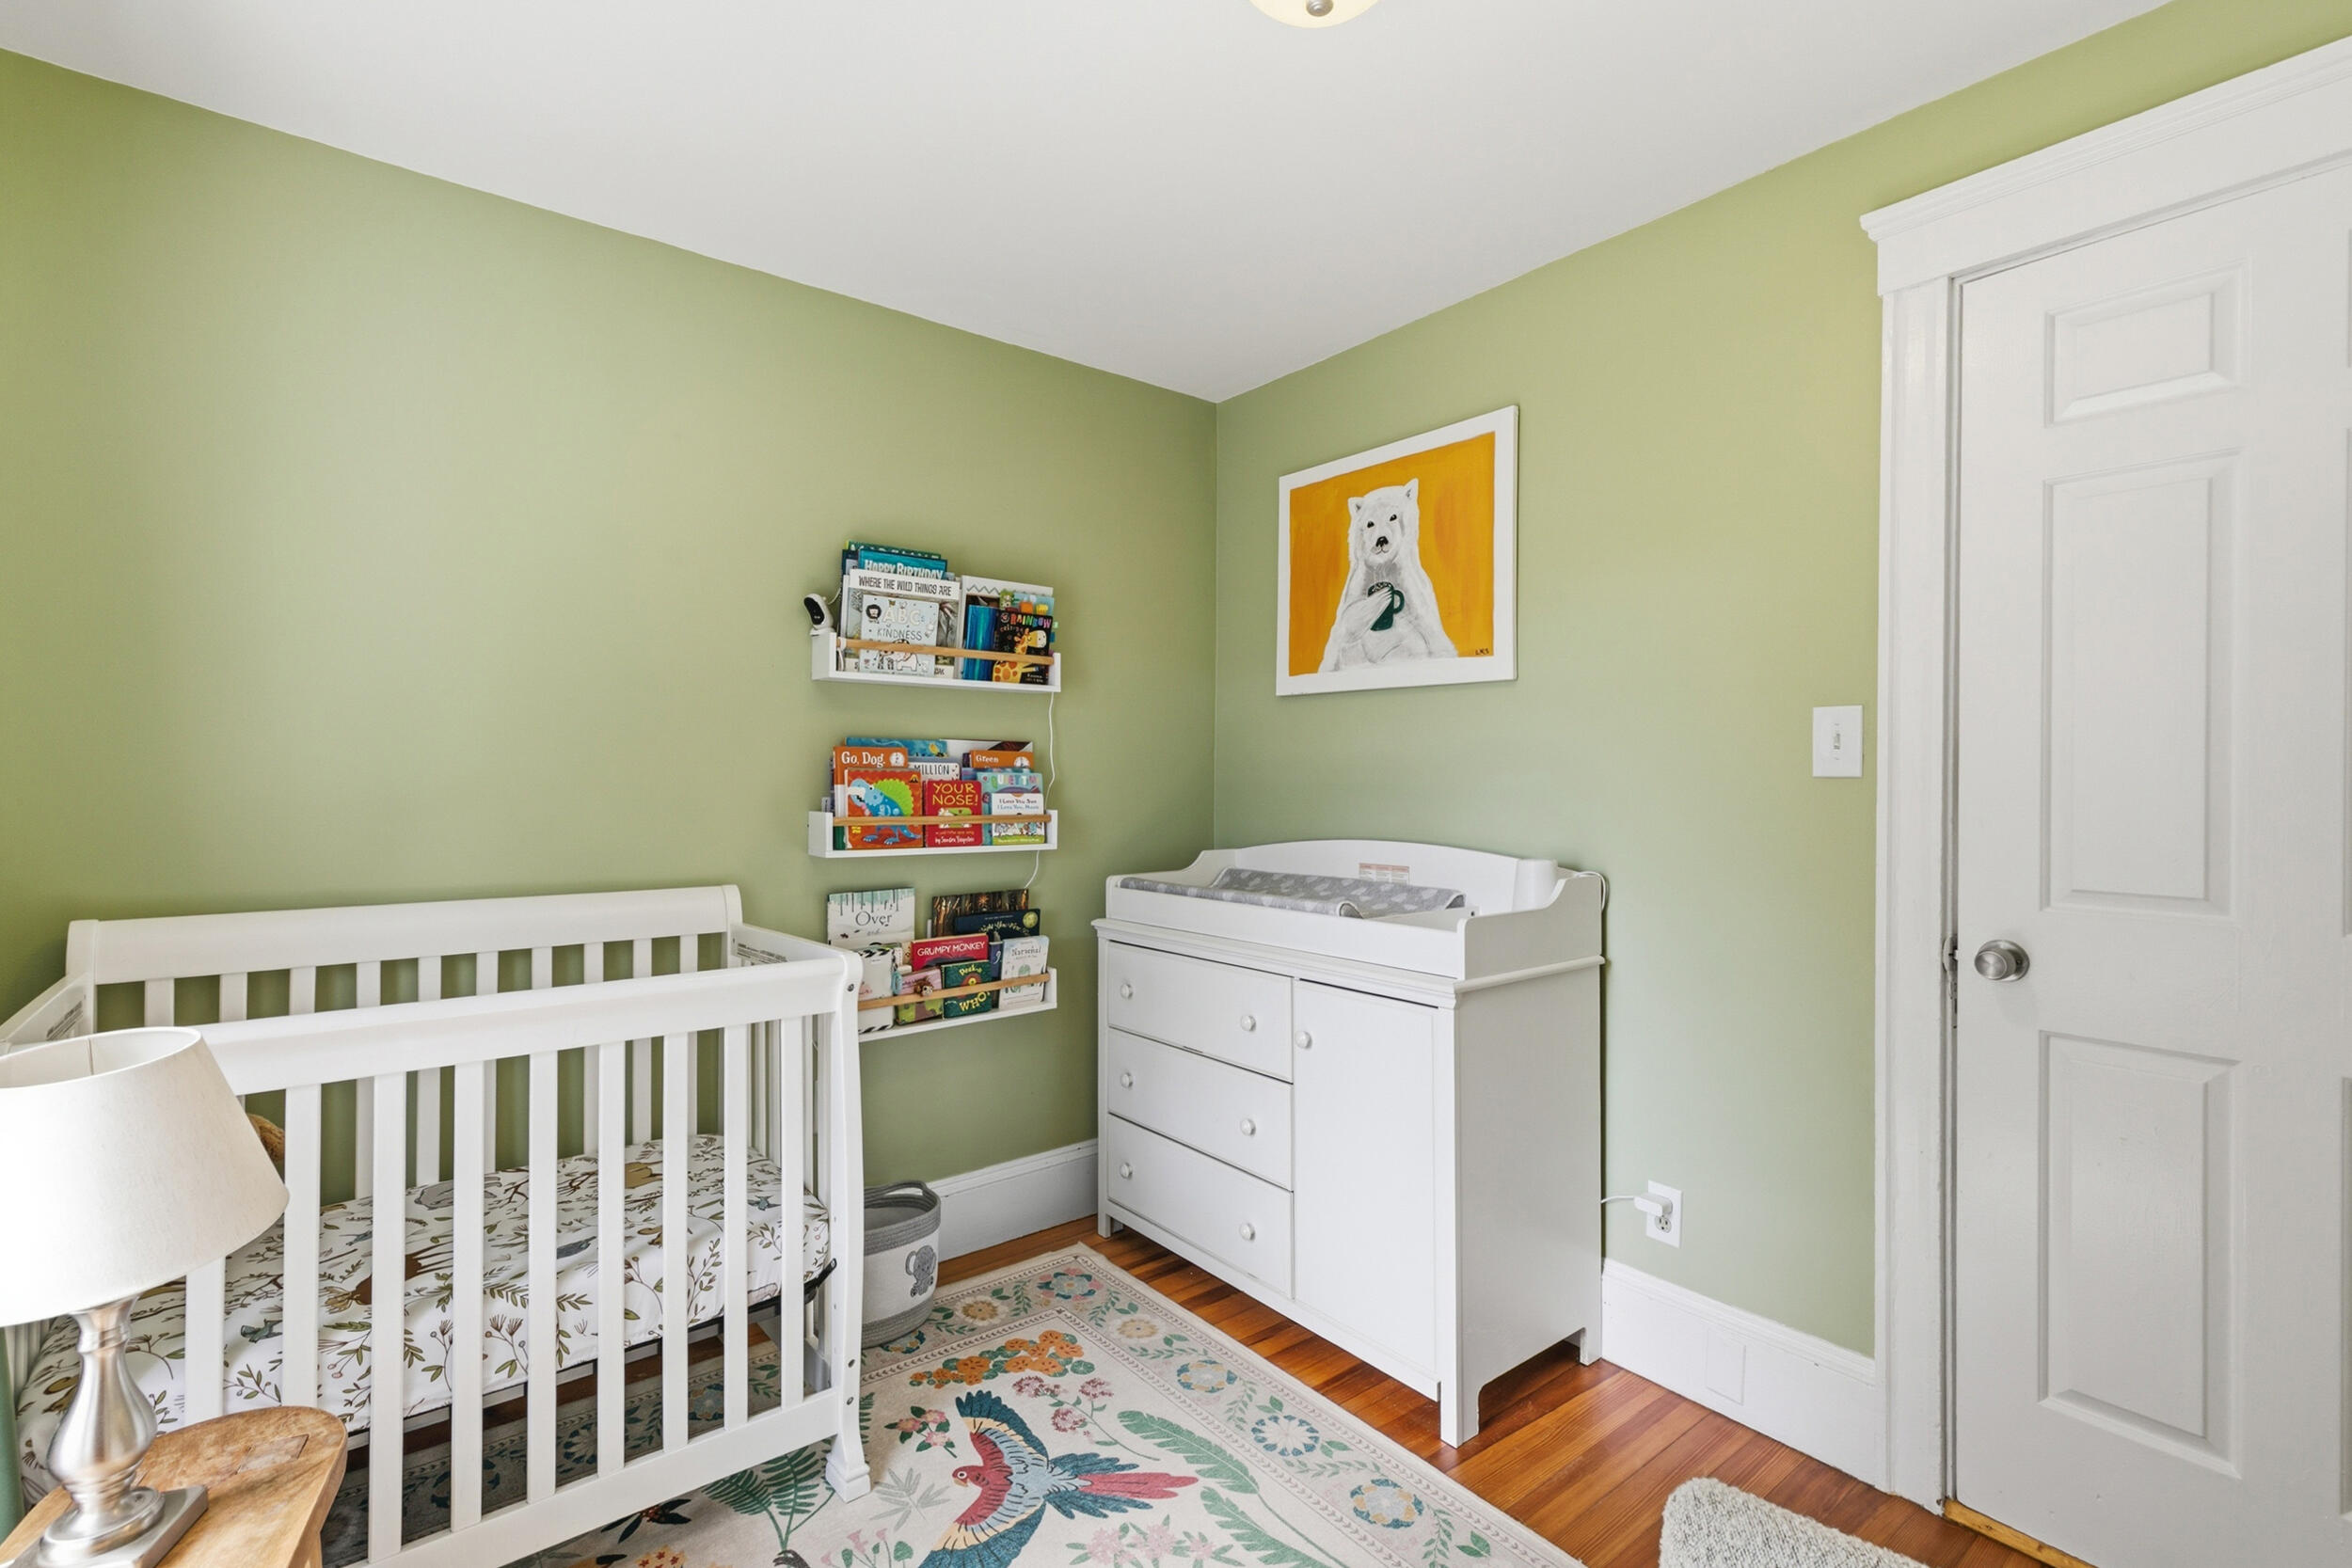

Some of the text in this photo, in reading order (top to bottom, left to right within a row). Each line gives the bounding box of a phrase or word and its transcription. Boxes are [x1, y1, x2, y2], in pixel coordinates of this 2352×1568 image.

[859, 576, 952, 596] WHERE THE WILD THINGS ARE
[1010, 613, 1052, 629] RAINBOW
[877, 627, 923, 641] KINDNESS
[841, 752, 885, 768] Go, Dog.
[976, 754, 999, 764] Green
[932, 783, 976, 795] YOUR
[932, 794, 978, 806] NOSE!
[855, 911, 893, 927] Over
[917, 942, 985, 957] GRUMPY MONKEY
[960, 991, 990, 1011] WHO
